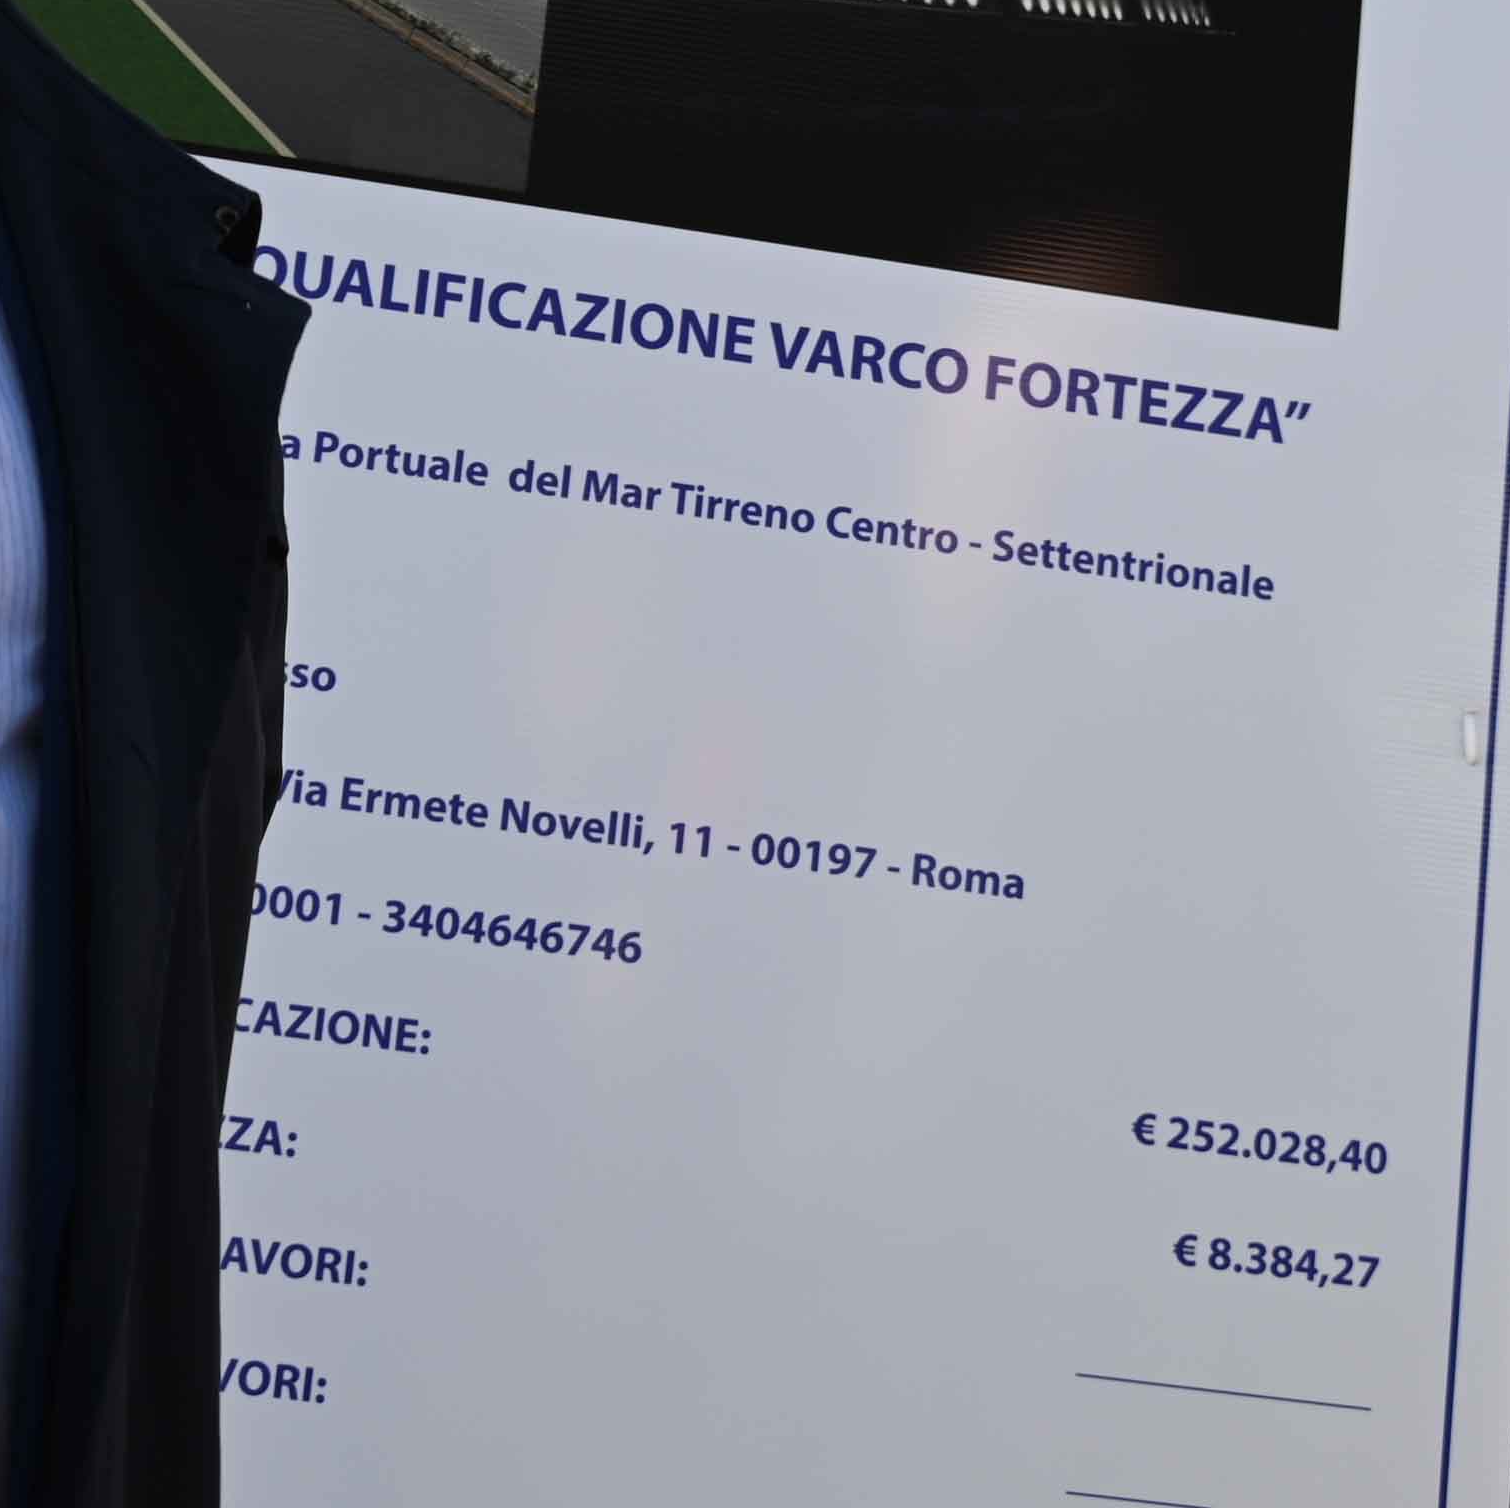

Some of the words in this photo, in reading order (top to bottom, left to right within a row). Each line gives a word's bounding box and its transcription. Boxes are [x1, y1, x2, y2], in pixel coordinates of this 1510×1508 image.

[769, 321, 969, 395] VARCO
[312, 430, 489, 487] Portuale
[508, 459, 572, 499] del
[581, 469, 663, 511] Mar
[670, 481, 816, 534] Tirreno
[825, 505, 959, 555] Centro
[992, 529, 1275, 601] Settentrionale
[283, 661, 337, 692] so
[339, 776, 489, 829] Ermete
[499, 797, 655, 856] Novelli,
[670, 822, 712, 858] 11
[751, 832, 878, 879] 00197
[911, 852, 1025, 900] Roma
[381, 899, 642, 964] 3404646746
[218, 1115, 298, 1159] ZA:
